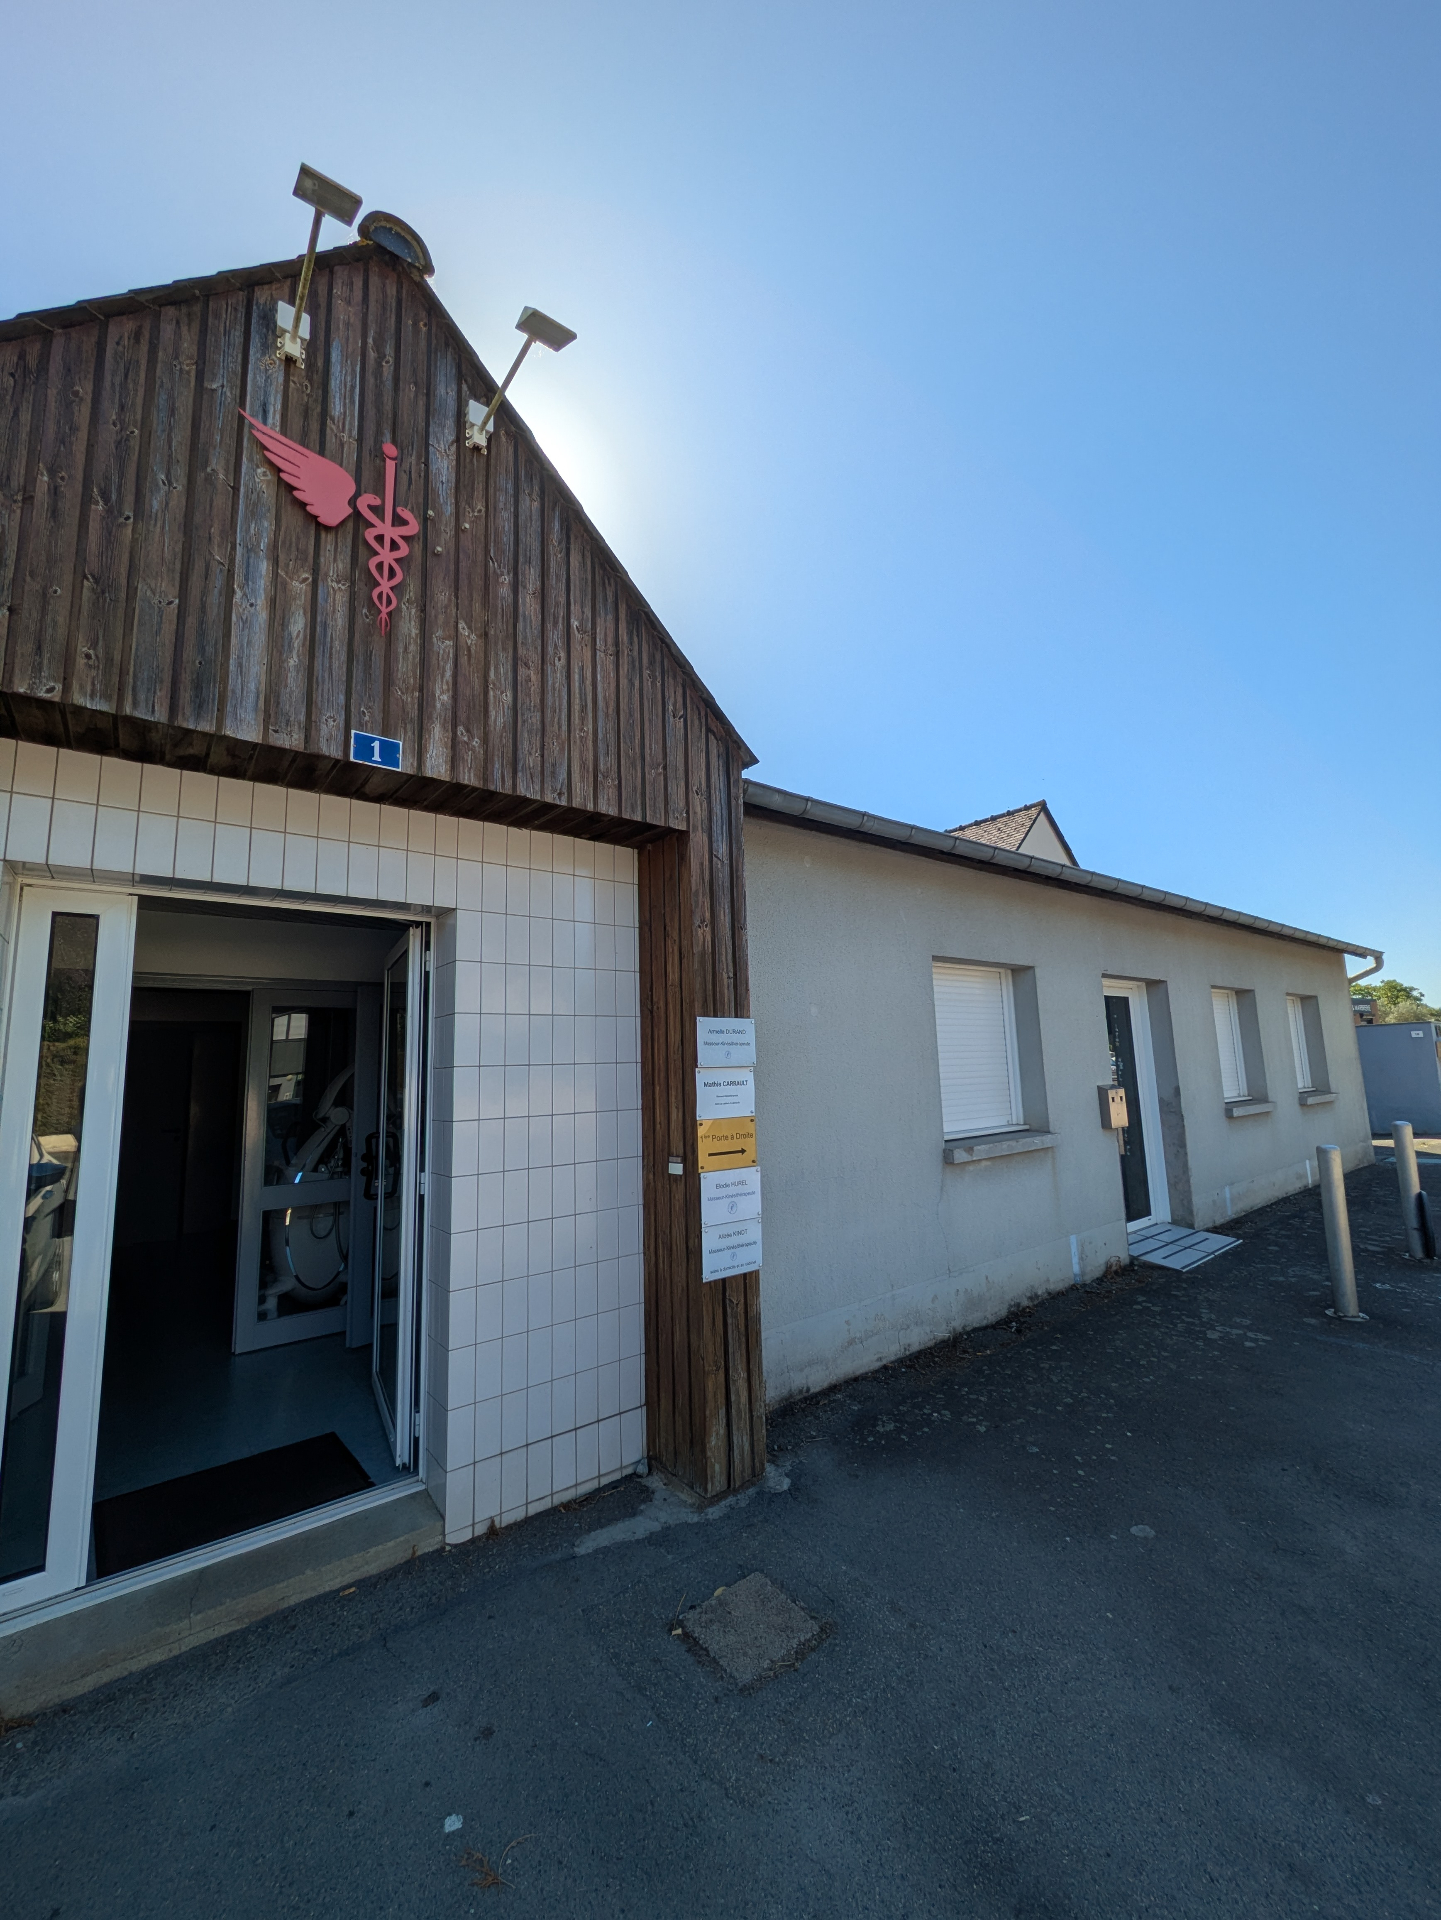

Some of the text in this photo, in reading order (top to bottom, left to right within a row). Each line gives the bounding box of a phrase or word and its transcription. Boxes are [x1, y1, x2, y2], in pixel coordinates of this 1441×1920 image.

[370, 740, 382, 762] 1
[711, 1134, 729, 1142] Porte
[730, 1133, 735, 1141] à
[735, 1132, 754, 1140] Droite
[730, 1180, 748, 1188] HUREL
